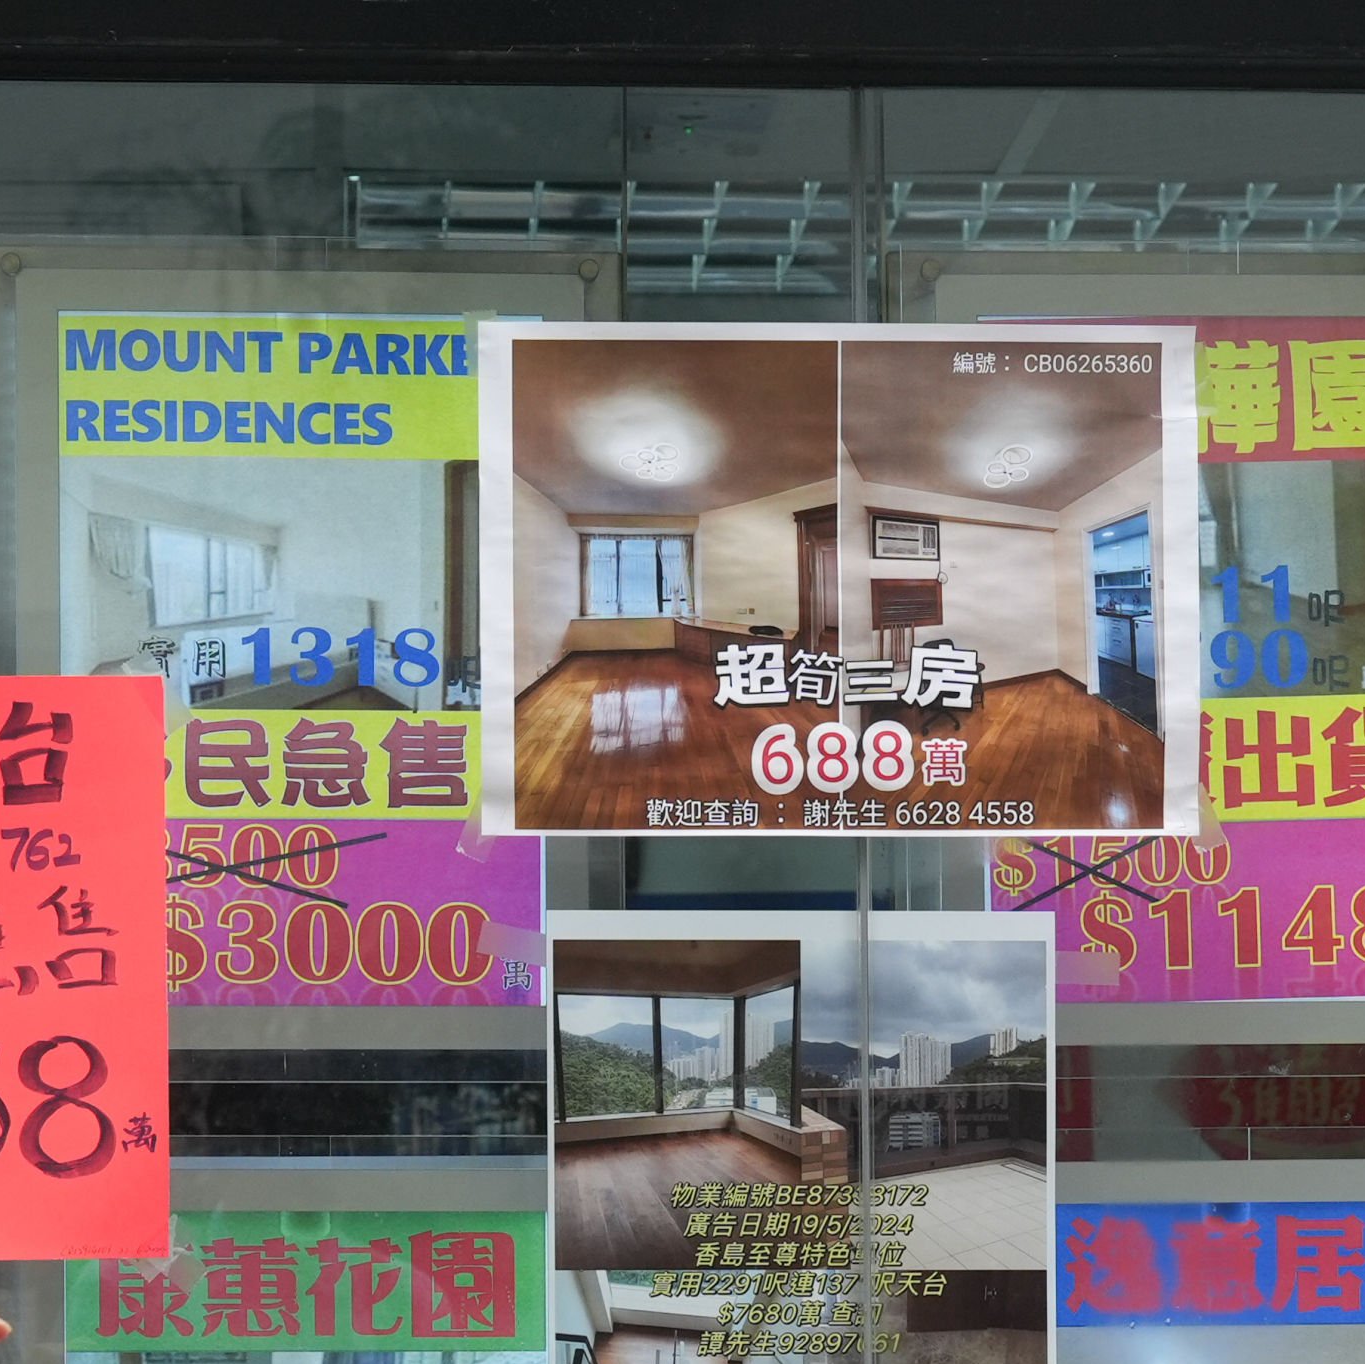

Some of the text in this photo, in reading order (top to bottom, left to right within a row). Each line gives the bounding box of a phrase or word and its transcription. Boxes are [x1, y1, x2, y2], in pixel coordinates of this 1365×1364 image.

[64, 329, 283, 373] MOUNT
[1023, 352, 1154, 376] CB06265360
[65, 400, 393, 446] RESIDENCES
[241, 626, 440, 688] 1318
[713, 642, 982, 712] 超筍三房
[1199, 628, 1309, 690] 90
[164, 715, 470, 810] 民急售
[749, 718, 917, 797] 688
[803, 799, 888, 829] 謝先生
[895, 800, 964, 827] 6628
[968, 800, 1035, 827] 4558
[649, 1271, 948, 1297] 實用2291呎連137呎天台
